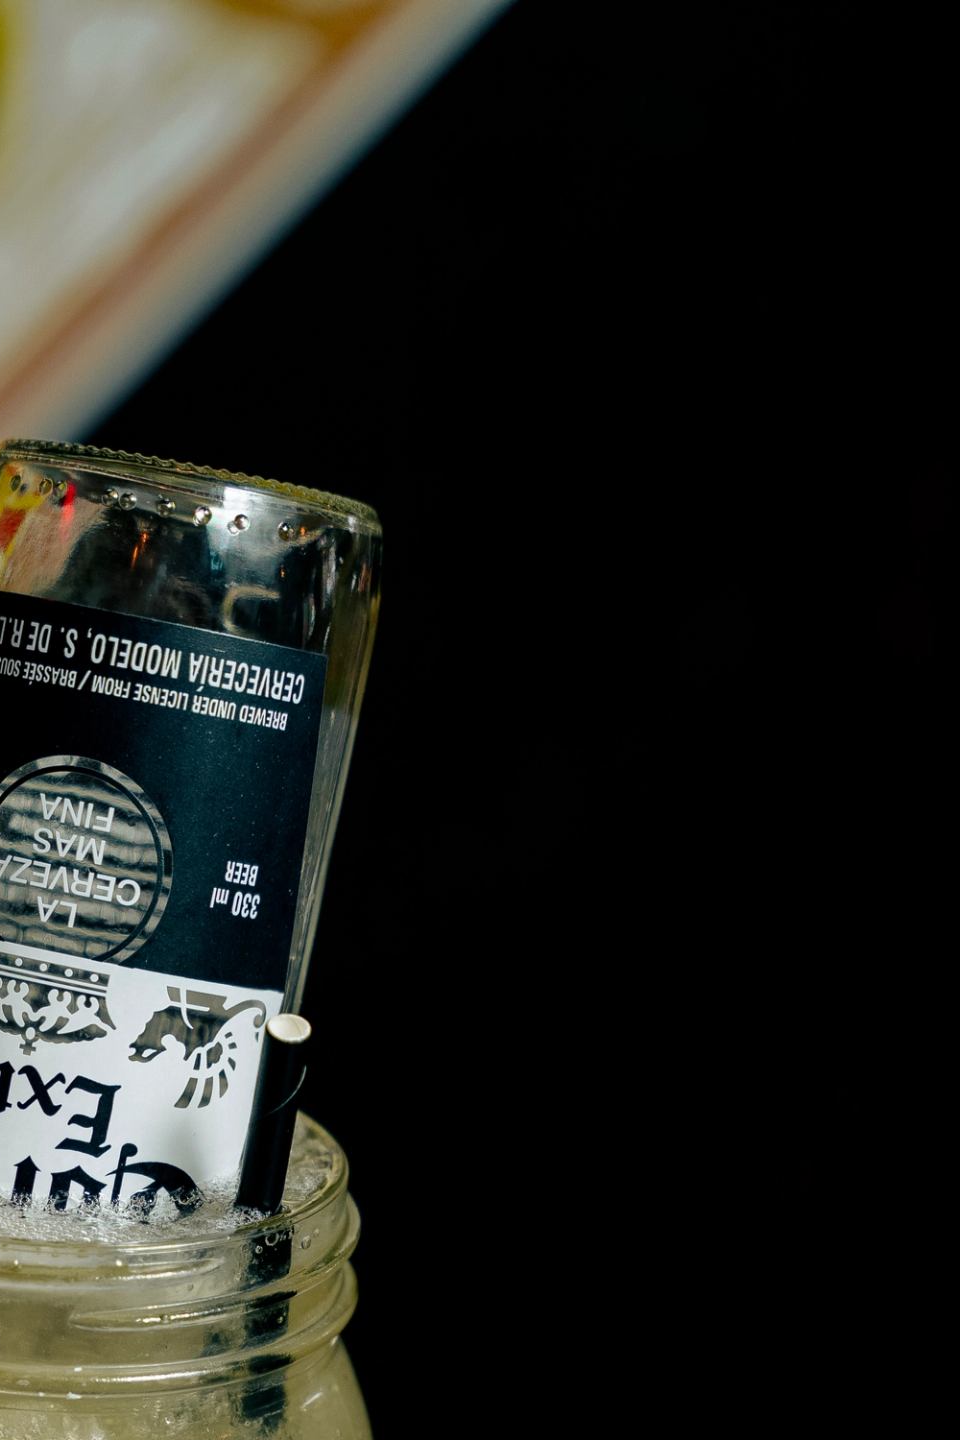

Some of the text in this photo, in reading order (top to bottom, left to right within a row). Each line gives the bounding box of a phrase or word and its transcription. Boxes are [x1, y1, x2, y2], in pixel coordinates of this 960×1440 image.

[26, 621, 52, 653] DE
[60, 627, 78, 659] S.
[87, 628, 182, 680] MODELO,
[22, 661, 77, 688] BRASSÉE
[91, 674, 131, 699] FROM
[189, 652, 305, 705] CERVECERÍA
[133, 683, 189, 711] LICENSE
[192, 695, 237, 721] UNDER
[239, 705, 289, 731] BREWED
[40, 793, 115, 833] FINA
[33, 827, 106, 865] MAS
[225, 861, 259, 887] BEER
[37, 895, 77, 928] LA
[210, 887, 261, 919] 330 ml
